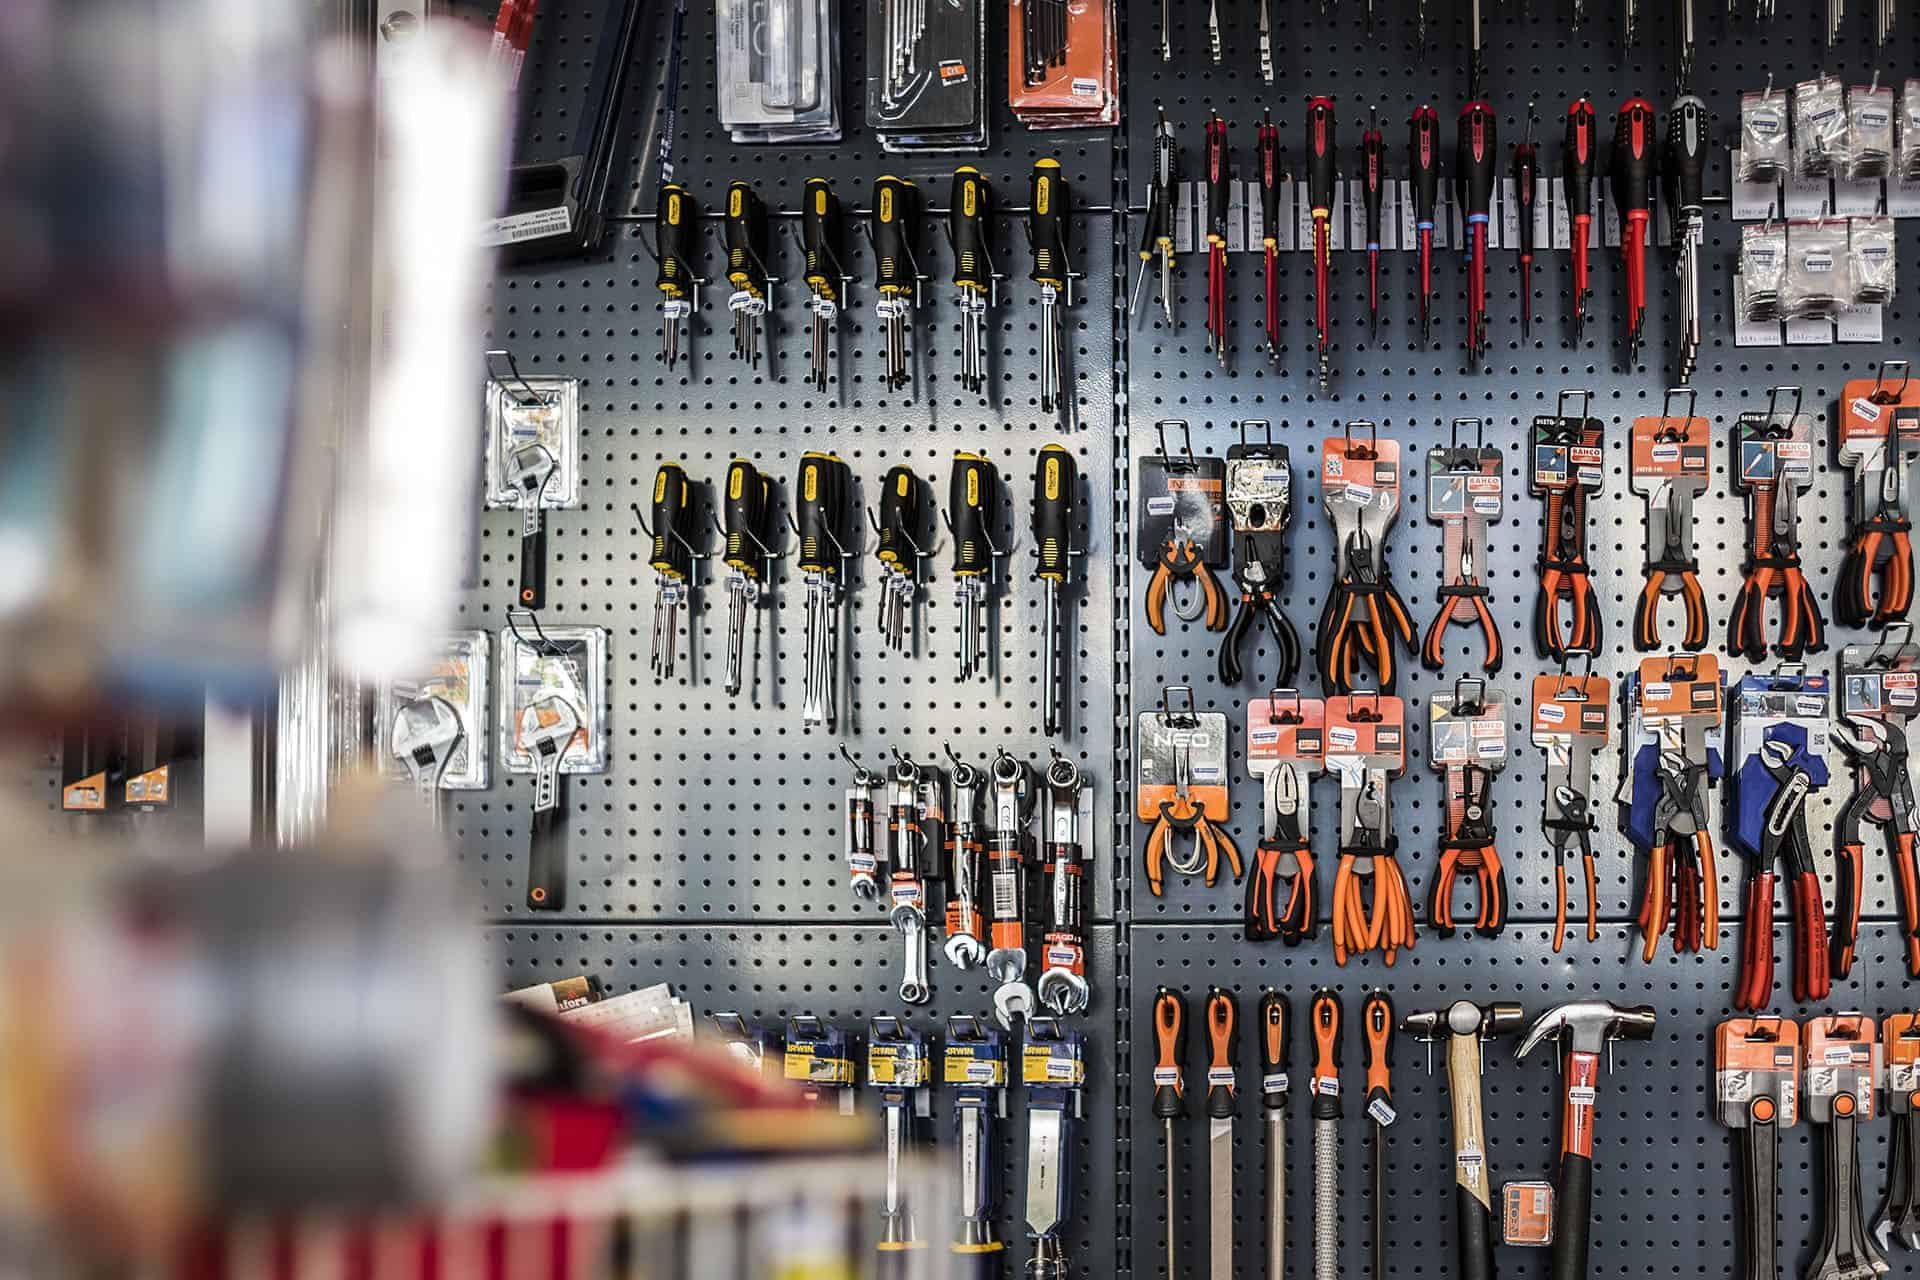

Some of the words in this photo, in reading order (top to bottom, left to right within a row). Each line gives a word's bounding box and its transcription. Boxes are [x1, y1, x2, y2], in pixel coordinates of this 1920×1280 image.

[1153, 733, 1210, 748] NEO
[946, 1047, 974, 1056] IRWIN
[1024, 1046, 1052, 1056] IRWIN
